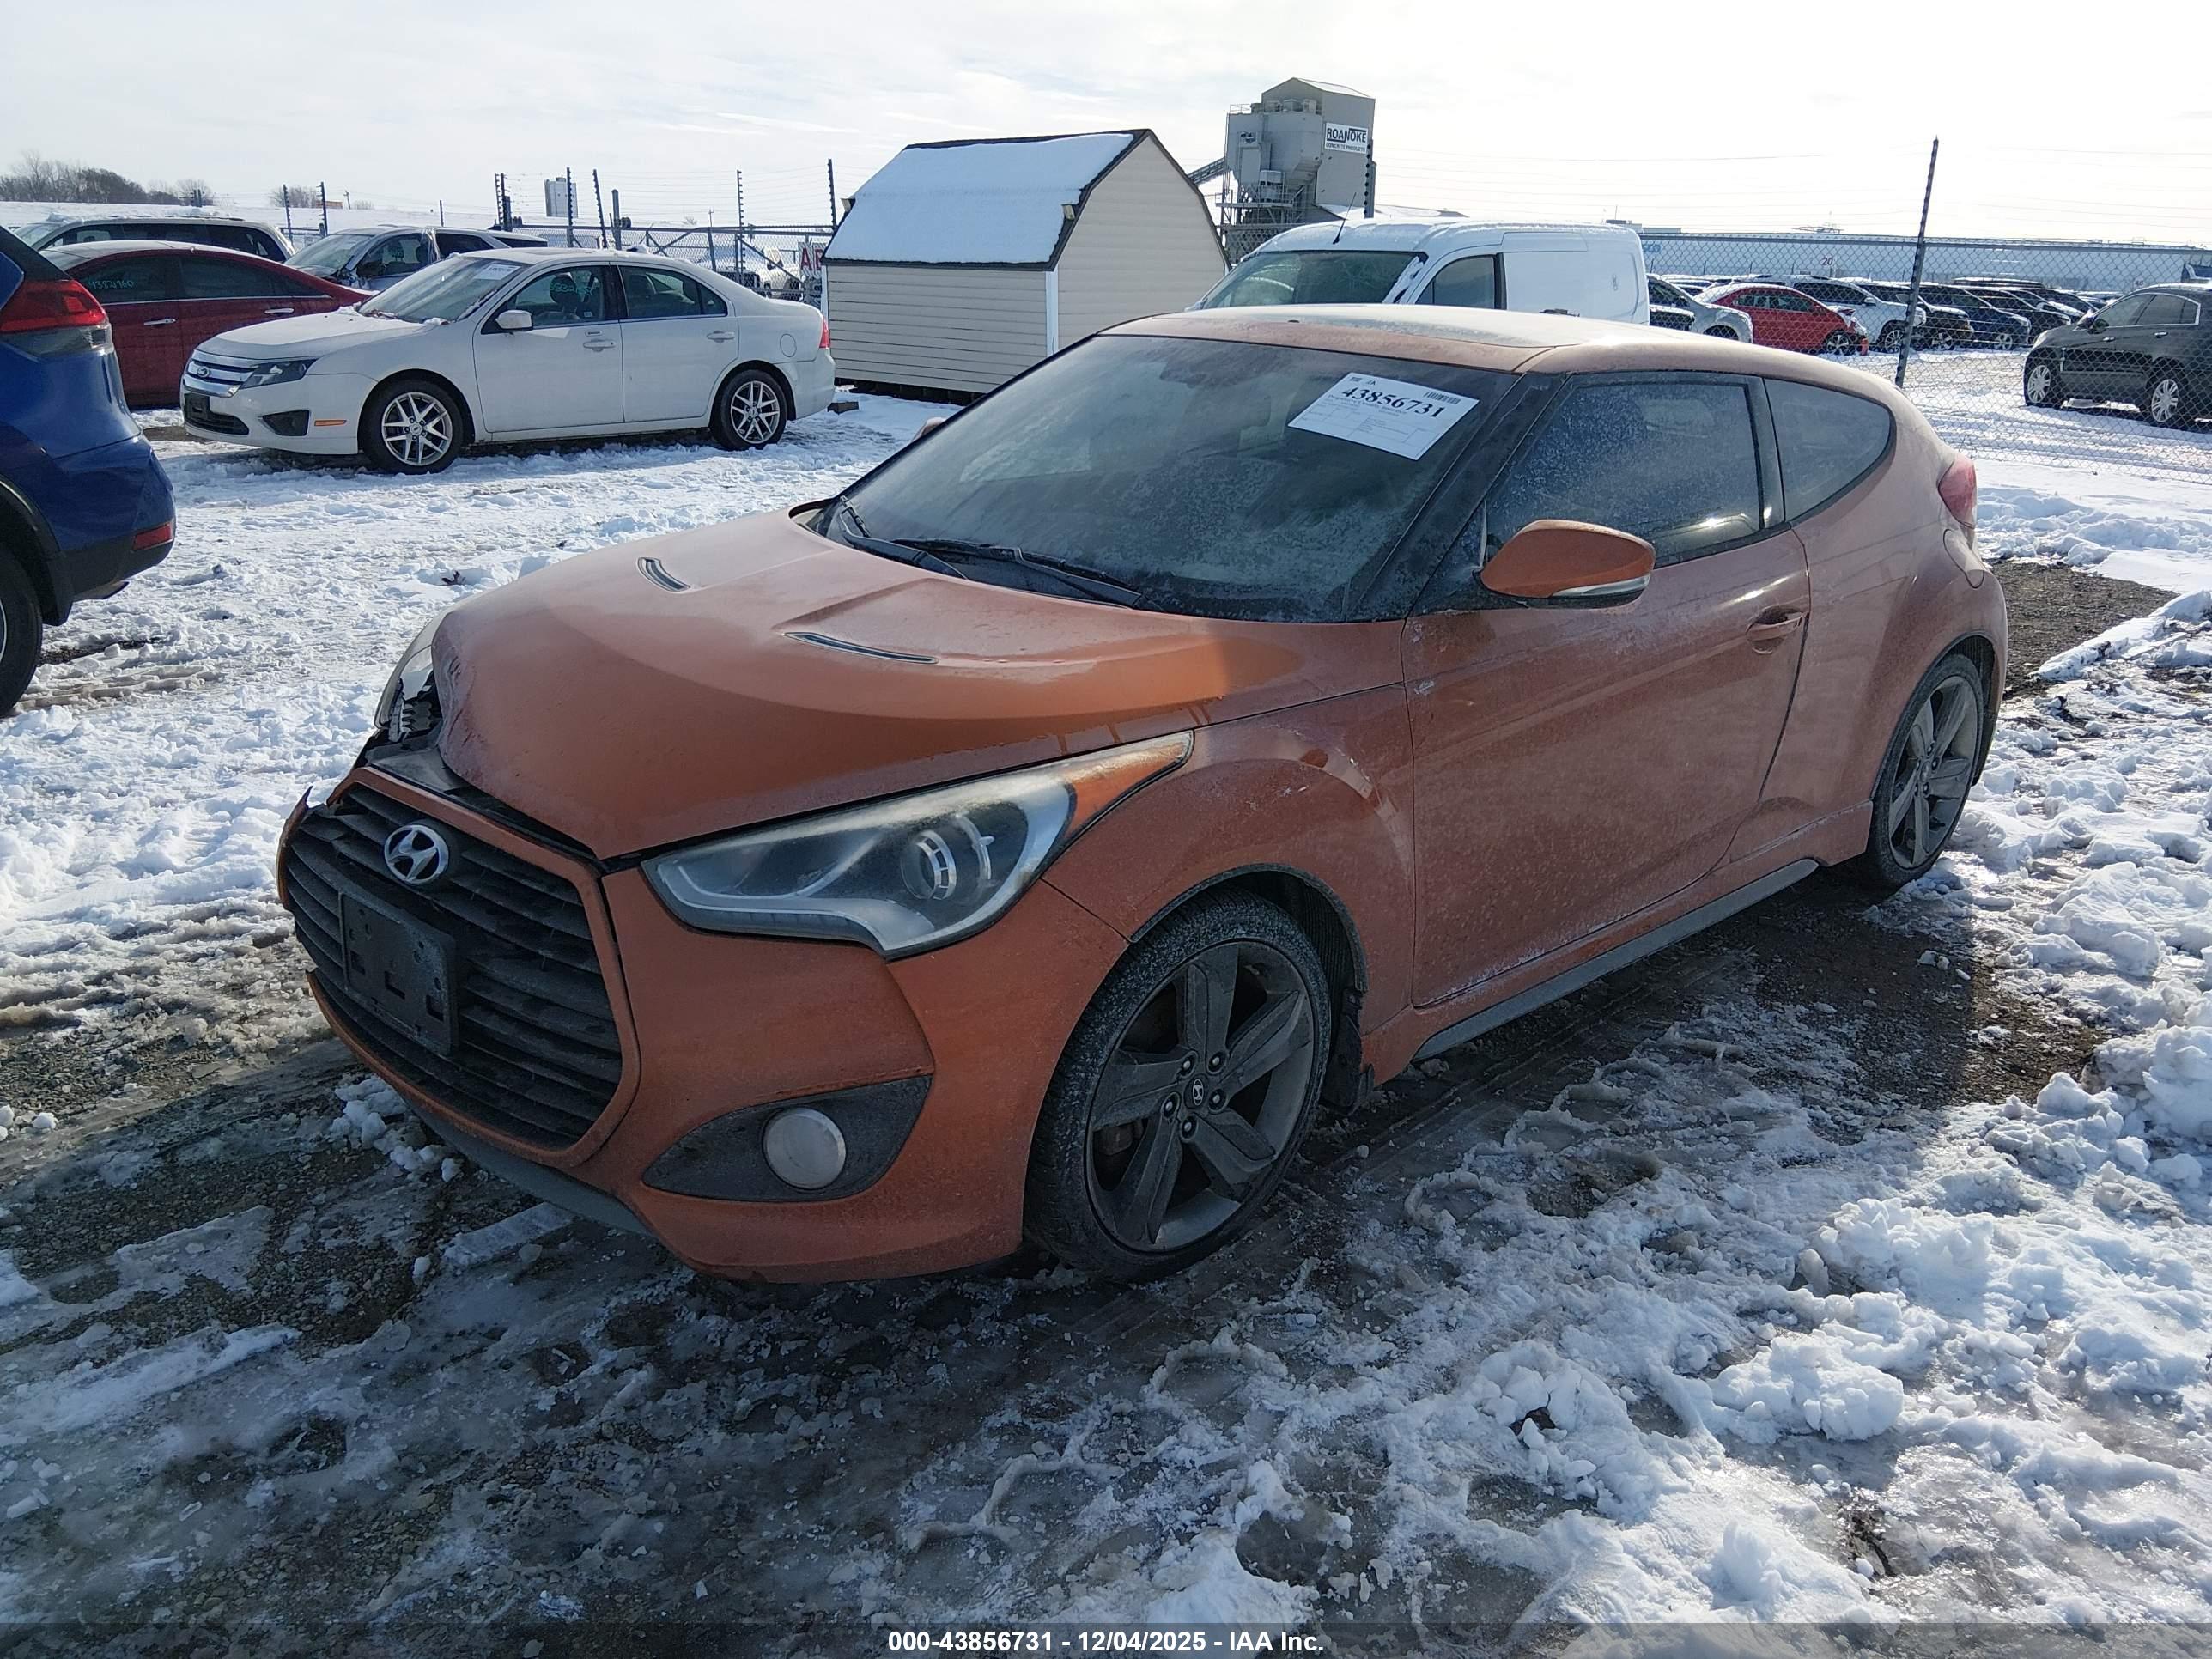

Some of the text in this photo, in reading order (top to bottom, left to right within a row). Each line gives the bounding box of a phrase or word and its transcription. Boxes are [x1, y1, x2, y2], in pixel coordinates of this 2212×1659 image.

[1327, 128, 1367, 143] ROANOKE
[1326, 142, 1346, 150] CONCRETE
[1821, 257, 1833, 266] 20
[1341, 387, 1445, 417] 43856731
